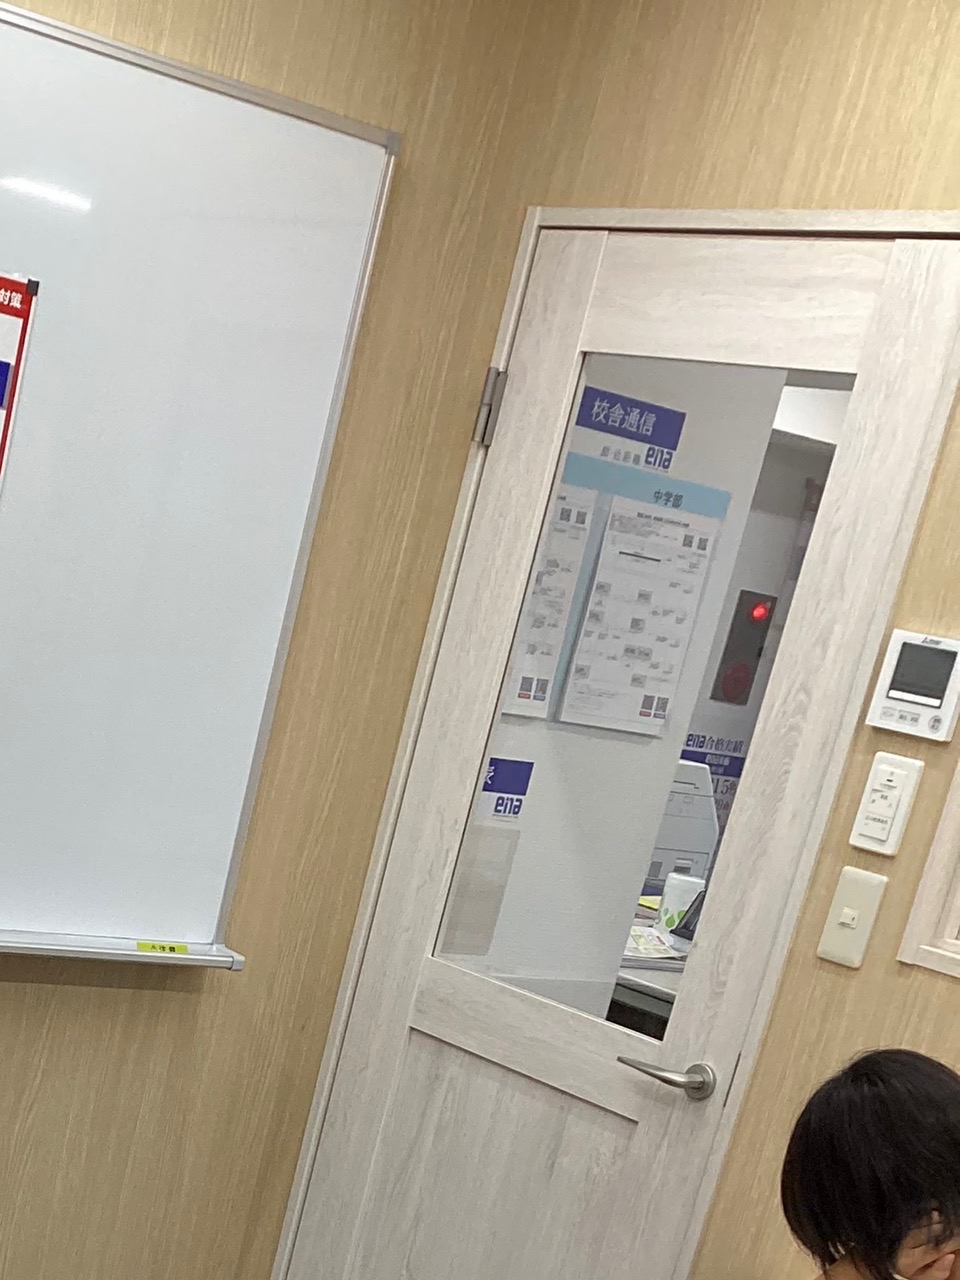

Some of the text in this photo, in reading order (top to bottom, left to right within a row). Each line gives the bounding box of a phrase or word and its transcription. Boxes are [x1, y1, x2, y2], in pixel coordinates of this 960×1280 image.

[591, 397, 657, 436] 校舎通信
[644, 446, 673, 470] ena
[653, 488, 684, 509] 中学部
[494, 796, 523, 815] ena
